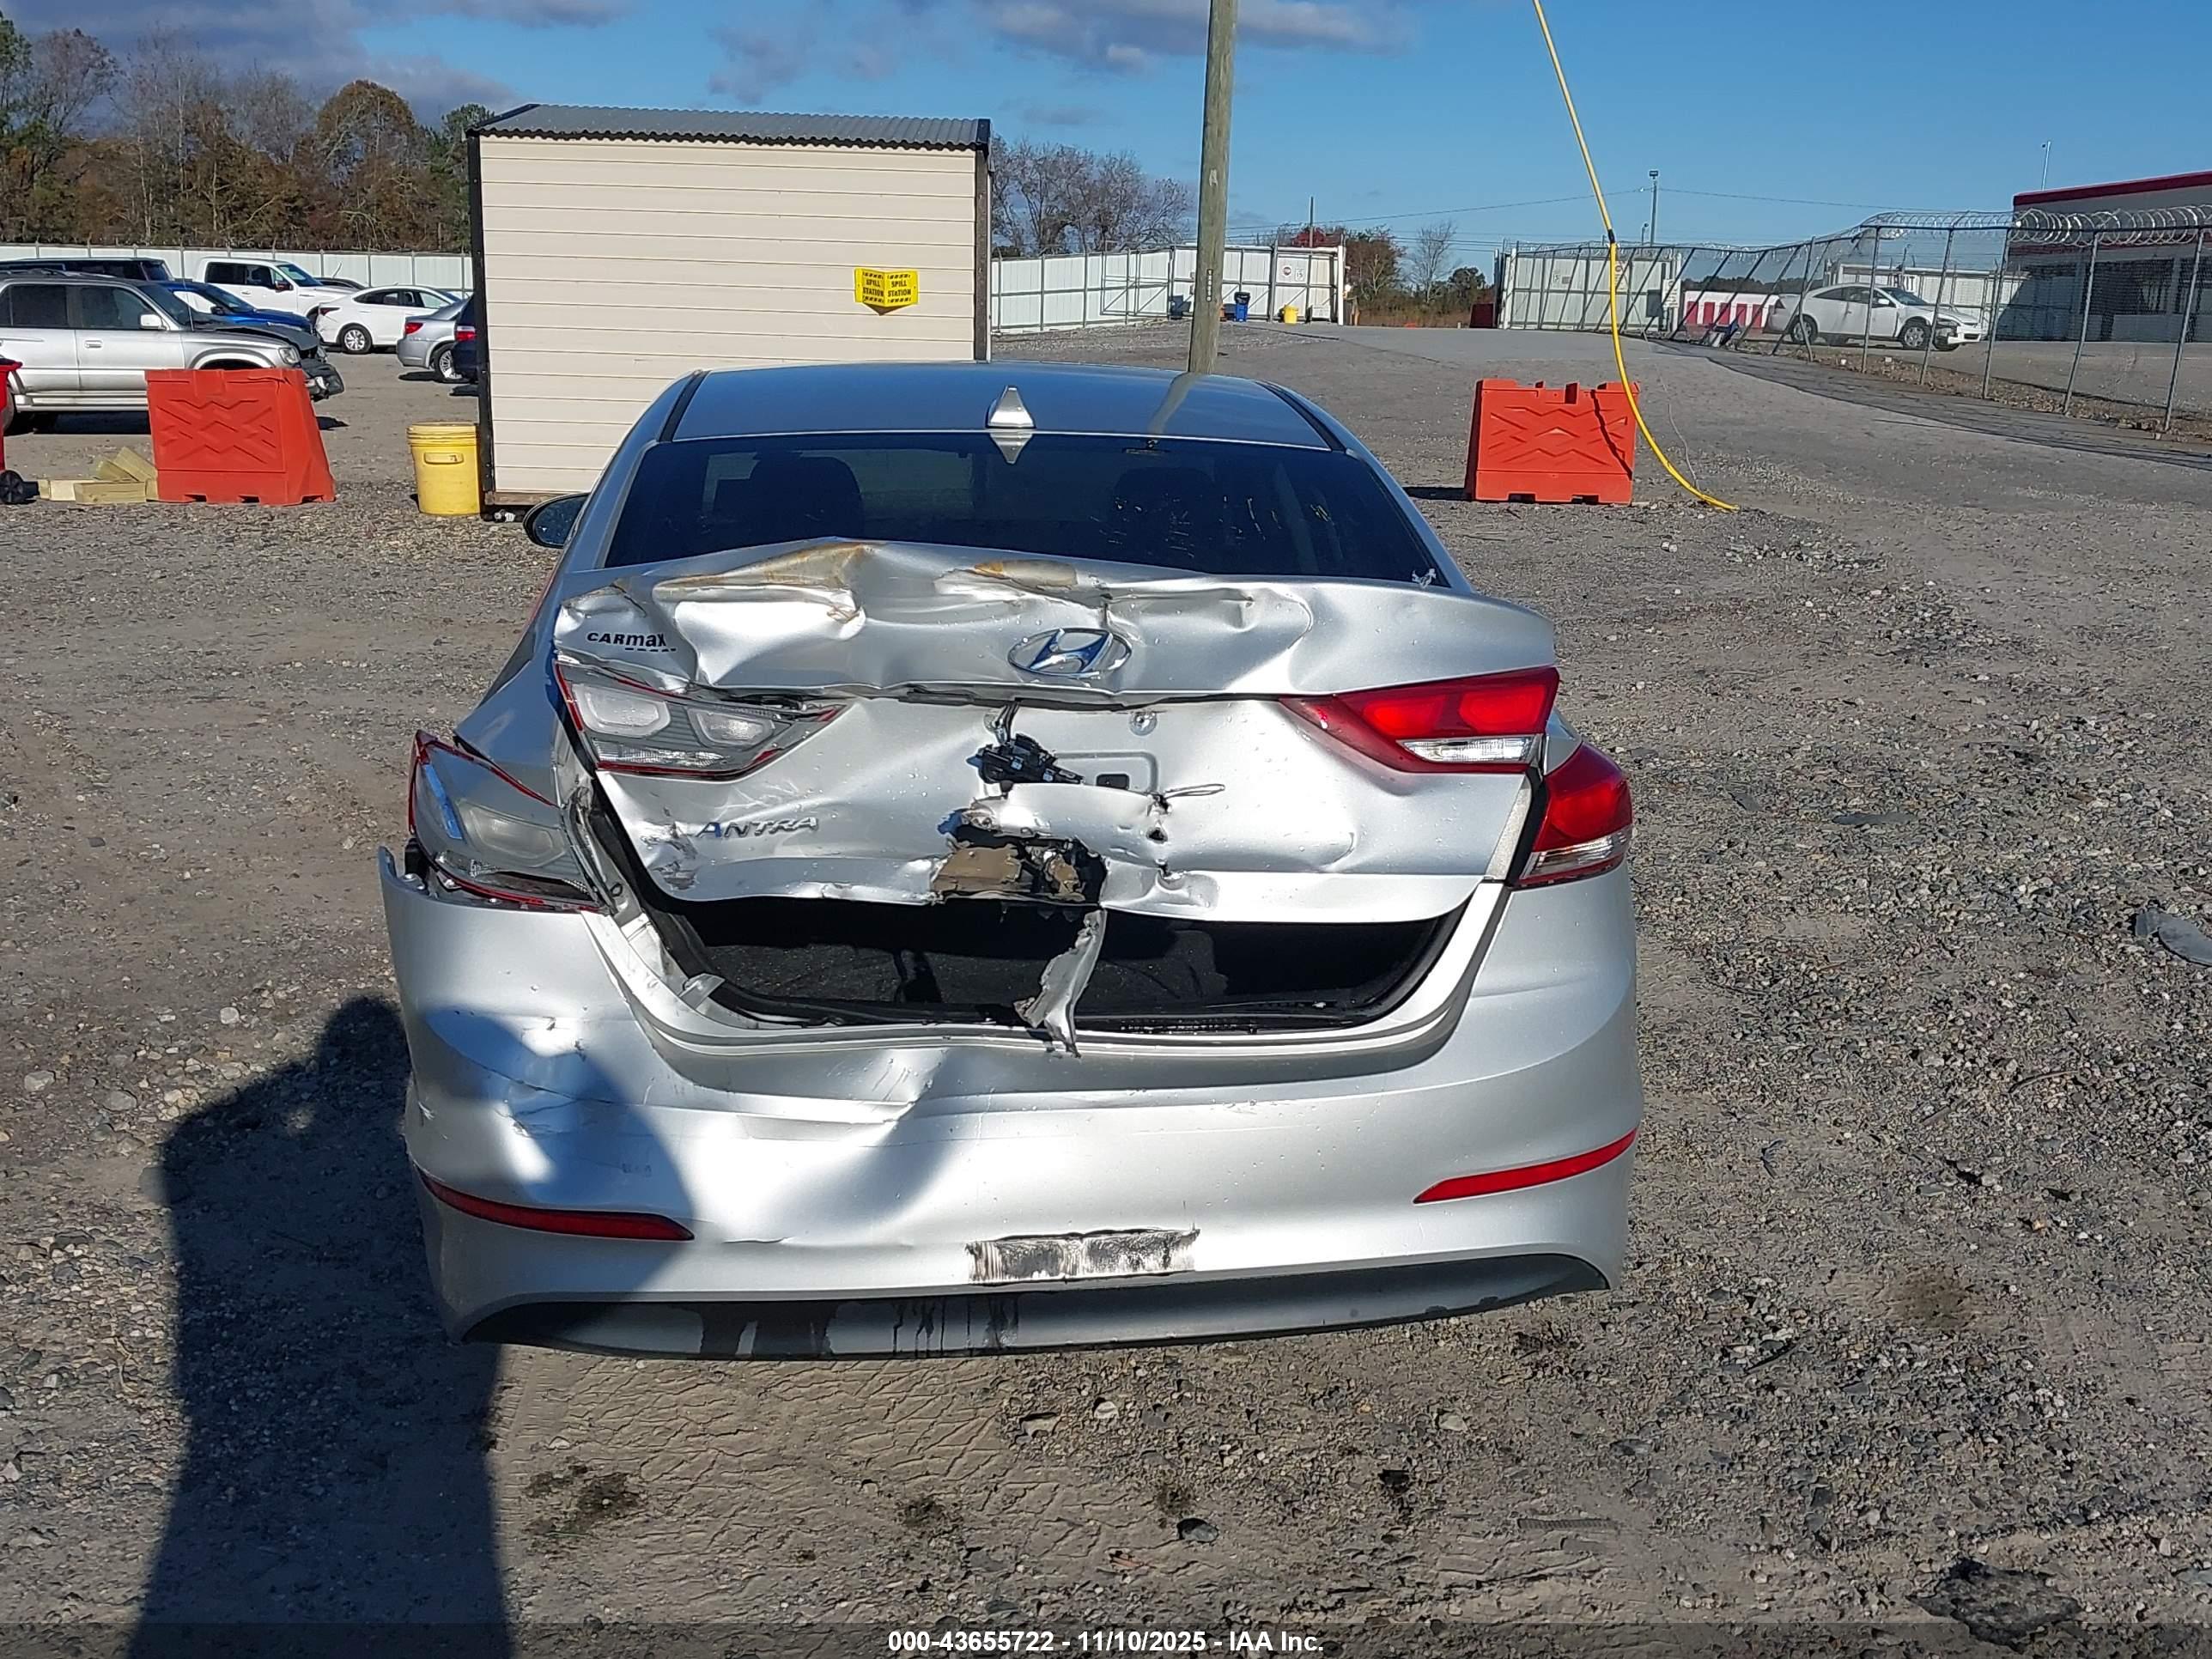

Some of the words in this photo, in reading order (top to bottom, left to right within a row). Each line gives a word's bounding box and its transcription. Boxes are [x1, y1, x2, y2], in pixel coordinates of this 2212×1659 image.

[866, 279, 881, 288] SPILL
[891, 279, 908, 288] SPILL
[862, 287, 884, 297] STATION
[887, 289, 912, 297] STATION
[696, 817, 818, 838] ANTRA
